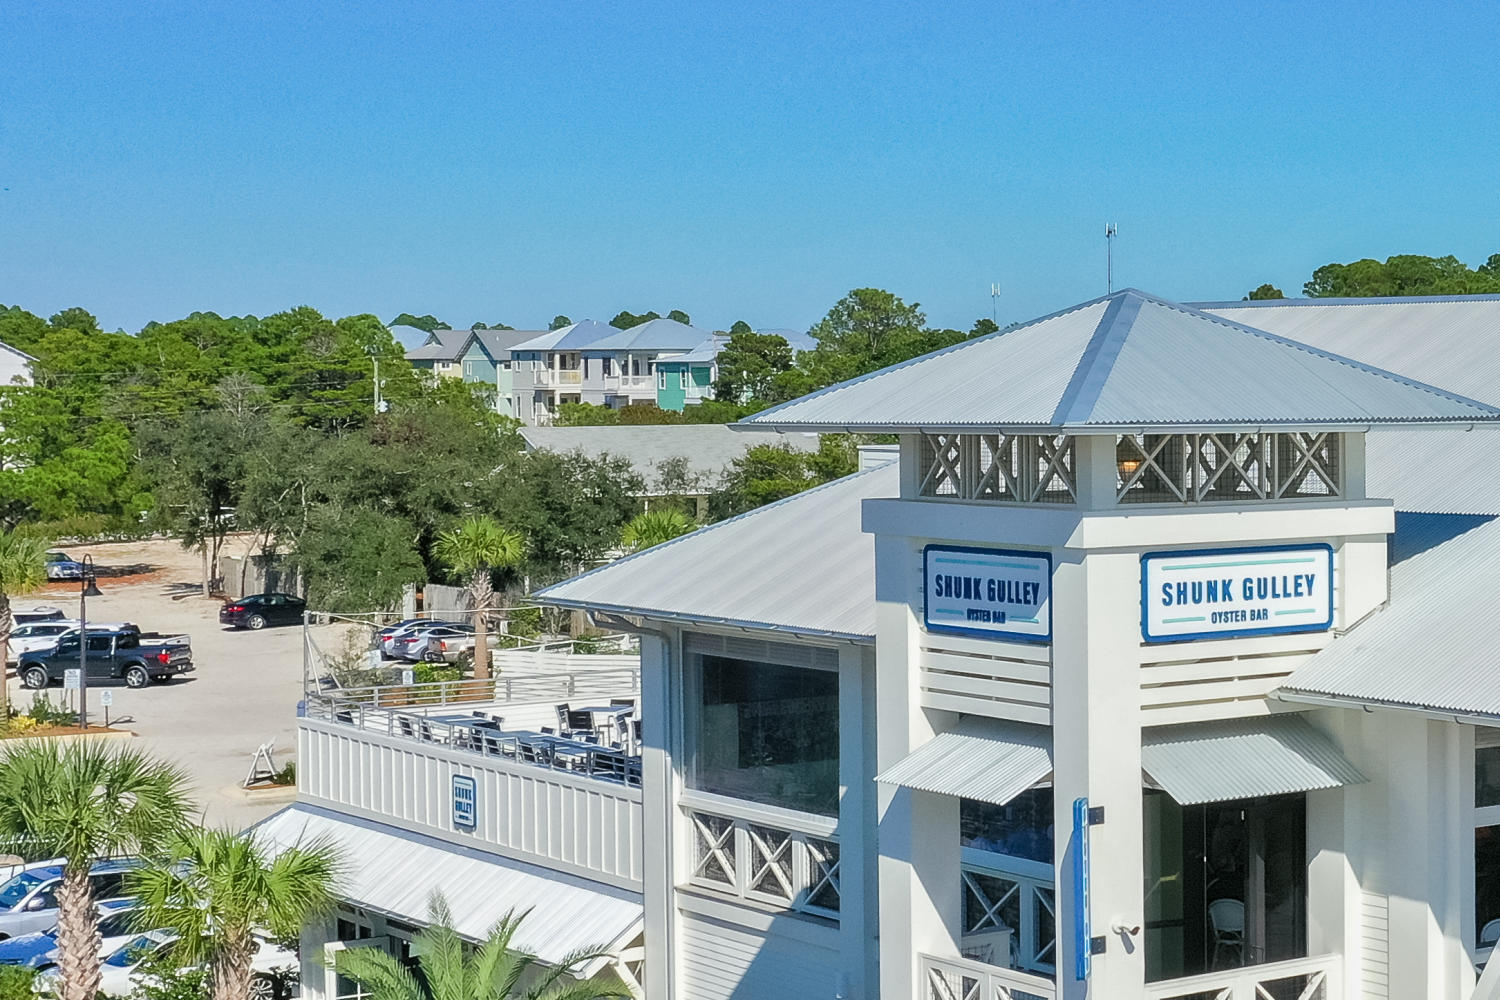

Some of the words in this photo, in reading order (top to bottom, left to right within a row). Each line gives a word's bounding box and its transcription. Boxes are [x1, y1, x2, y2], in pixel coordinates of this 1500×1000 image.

[935, 573, 982, 601] SHUNK
[987, 578, 1040, 606] GULLEY
[1162, 578, 1234, 606] SHUNK
[1242, 573, 1316, 601] GULLEY
[967, 608, 991, 622] OYSTER
[992, 611, 1006, 624] BAR
[1211, 609, 1247, 624] OYSTER
[1250, 608, 1268, 622] BAR
